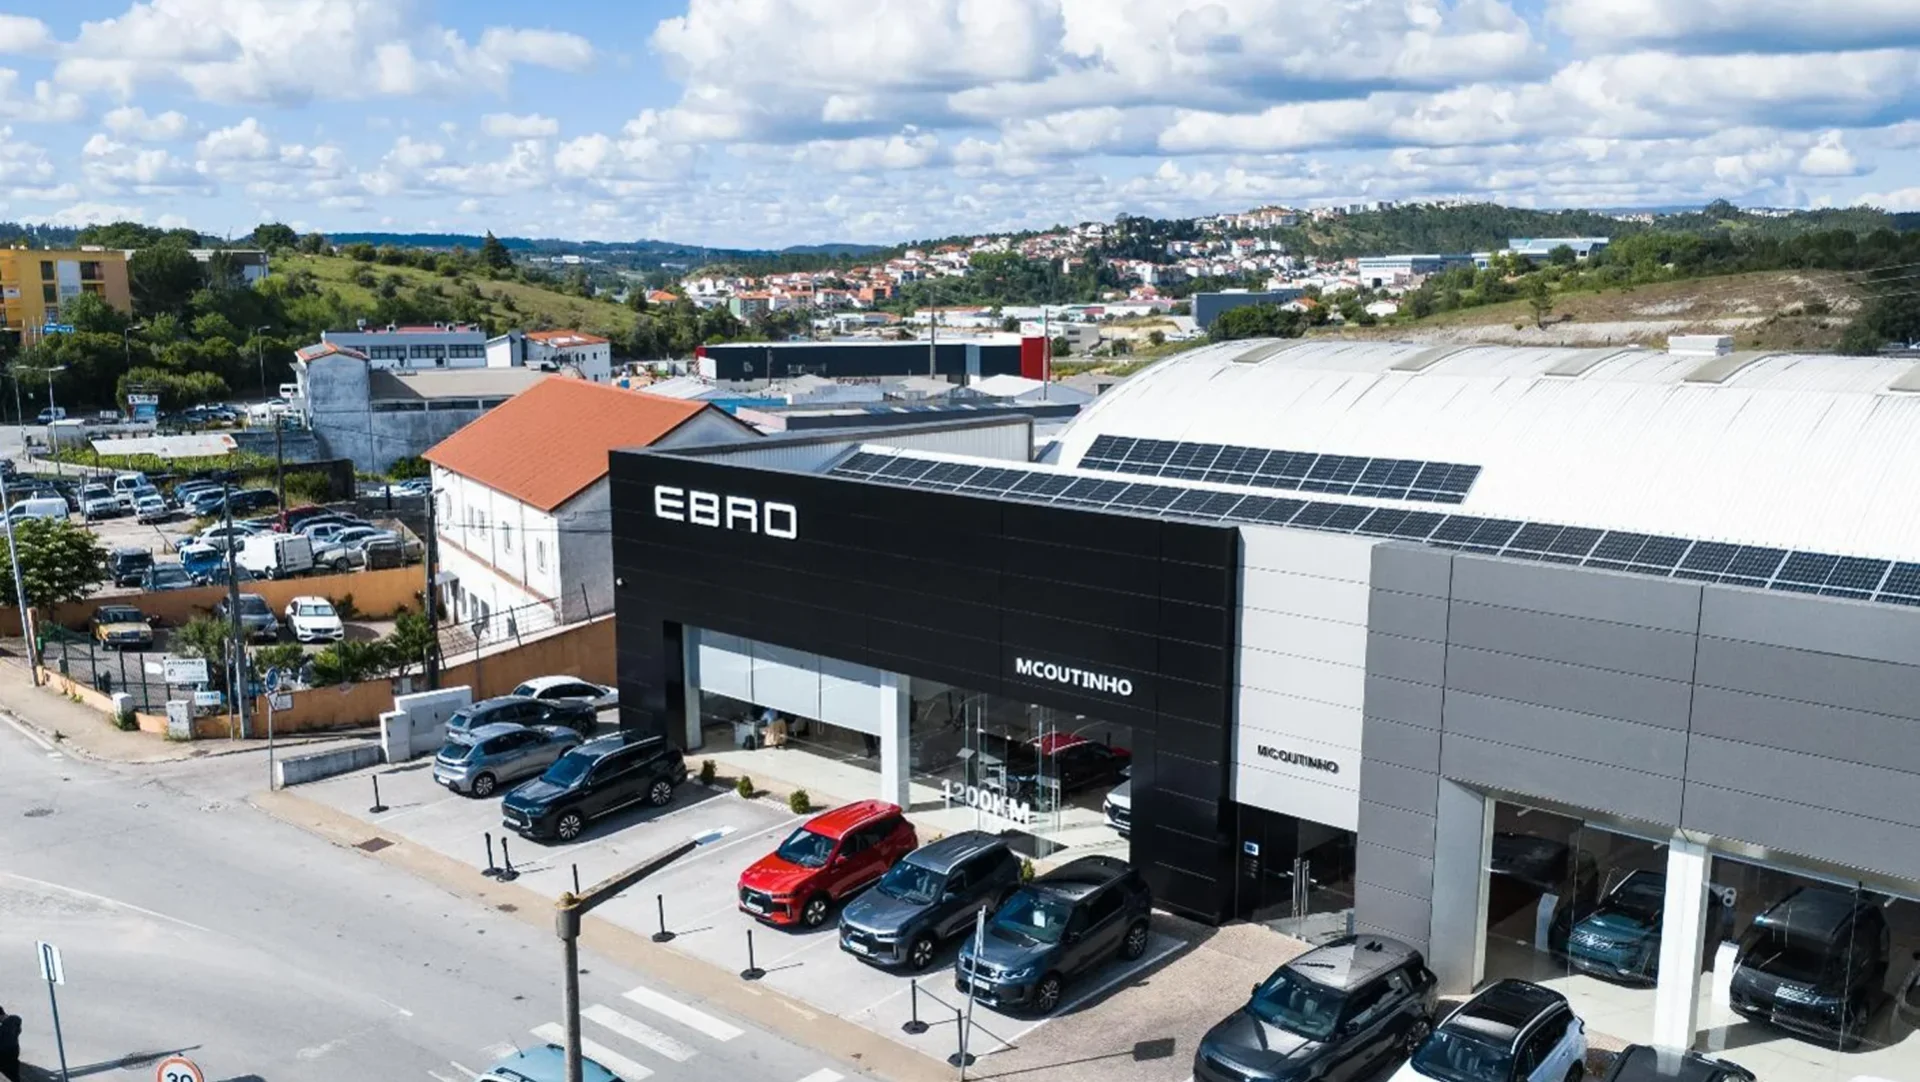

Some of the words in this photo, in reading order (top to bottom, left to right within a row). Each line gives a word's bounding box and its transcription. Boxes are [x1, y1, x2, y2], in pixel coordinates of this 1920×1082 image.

[654, 485, 797, 540] EBRO
[1016, 657, 1133, 696] MCOUTINHO
[1257, 744, 1340, 775] MCOUTINHO
